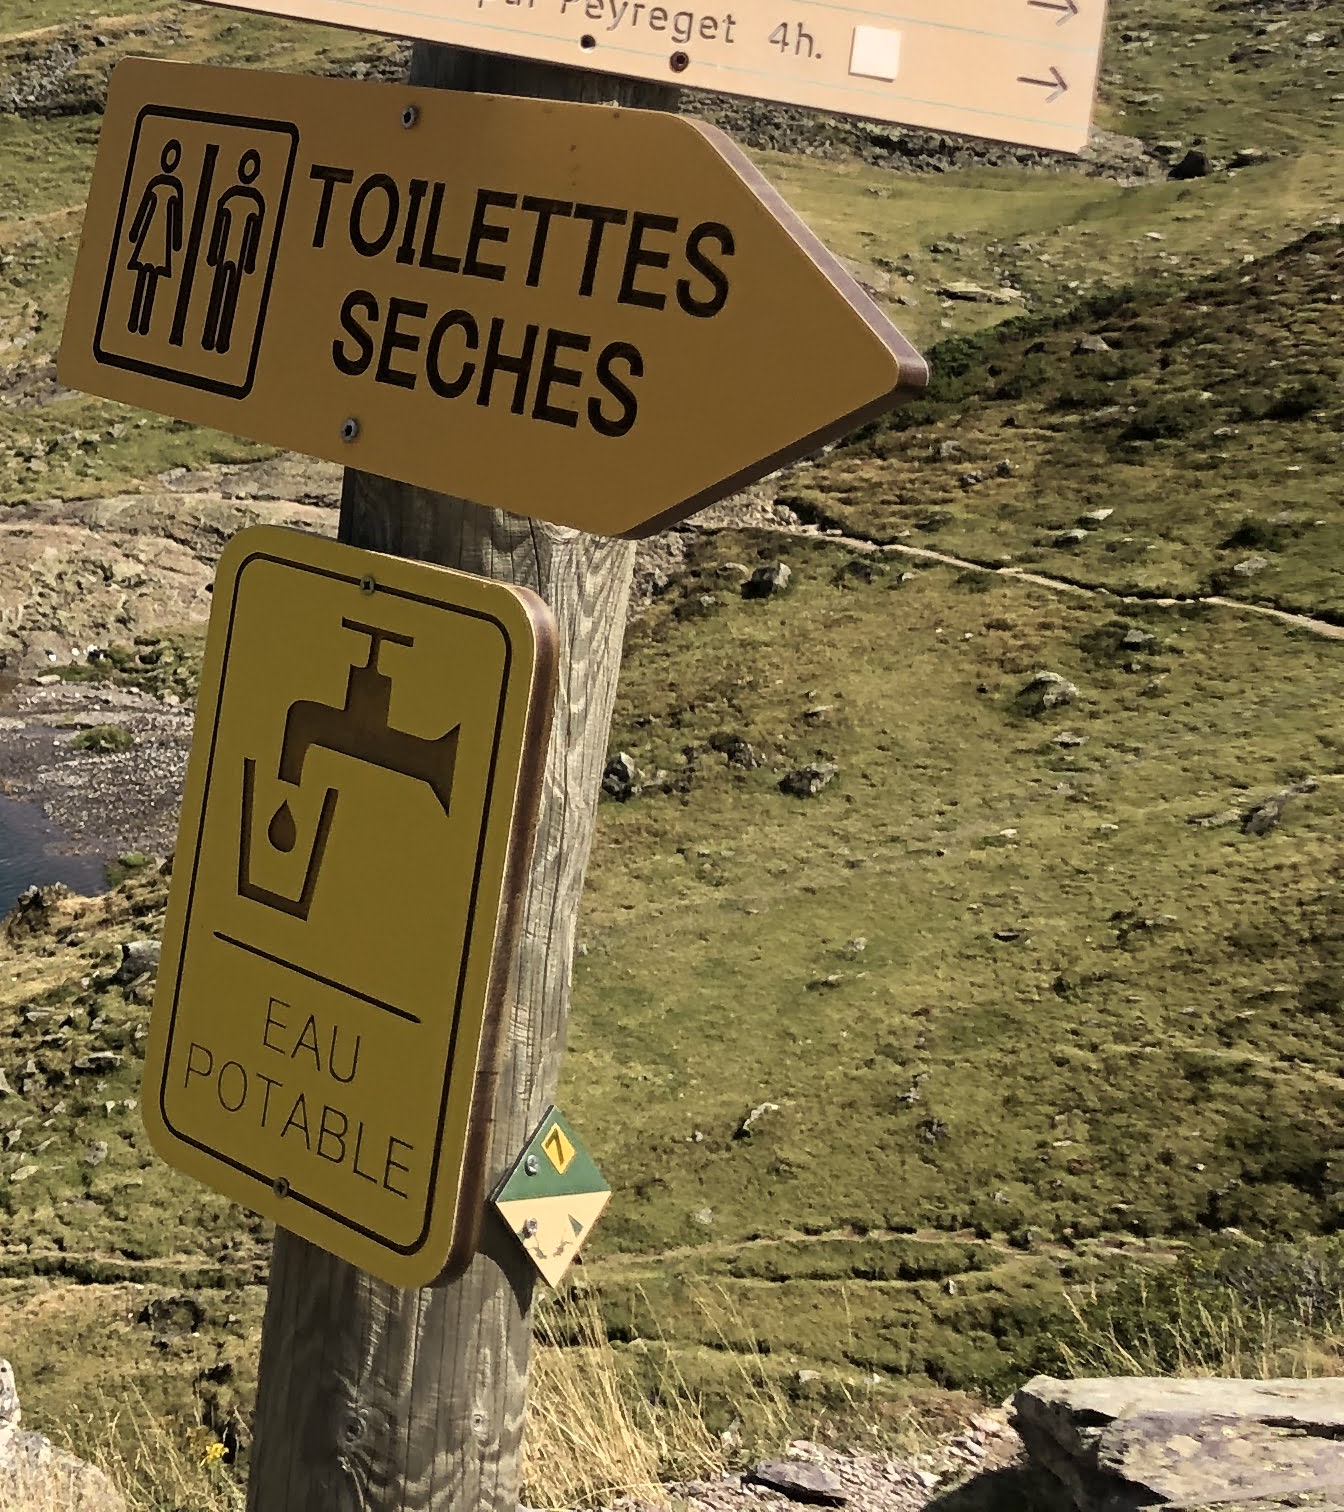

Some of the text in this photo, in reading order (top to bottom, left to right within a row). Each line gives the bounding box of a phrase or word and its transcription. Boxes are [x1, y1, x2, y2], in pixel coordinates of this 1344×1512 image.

[767, 21, 823, 60] 4h.
[310, 164, 735, 319] TOILETTES
[332, 290, 644, 438] SECHES
[262, 996, 361, 1083] EAU
[184, 1041, 414, 1200] POTABLE
